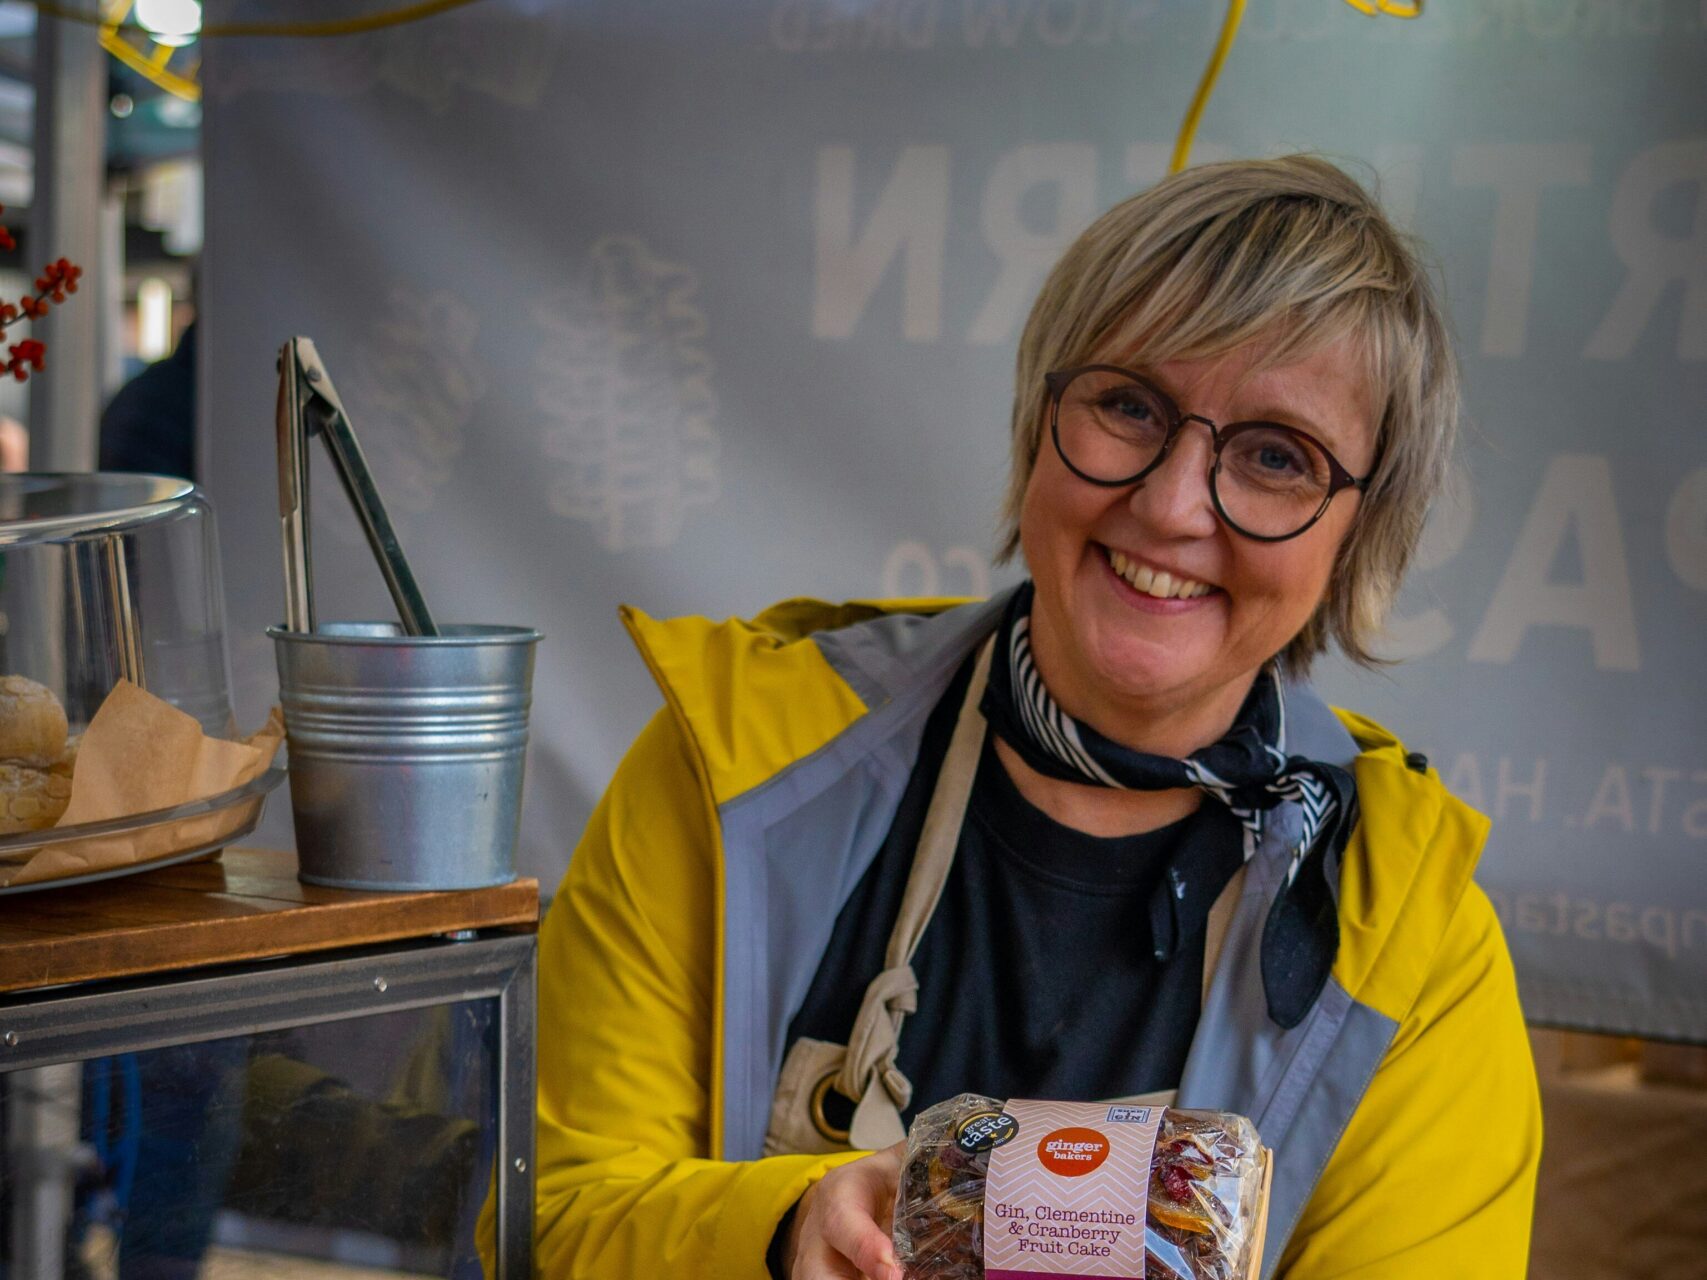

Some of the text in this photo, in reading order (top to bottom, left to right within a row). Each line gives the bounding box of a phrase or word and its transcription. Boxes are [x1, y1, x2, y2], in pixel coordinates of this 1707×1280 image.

[961, 1116, 1012, 1147] taste
[965, 1116, 991, 1134] great
[1046, 1139, 1103, 1153] ginger
[1053, 1151, 1092, 1162] bakers
[995, 1203, 1135, 1226] Gin, Clementine
[1008, 1221, 1121, 1245] & Cranberry
[1018, 1238, 1111, 1257] Fruit Cake
